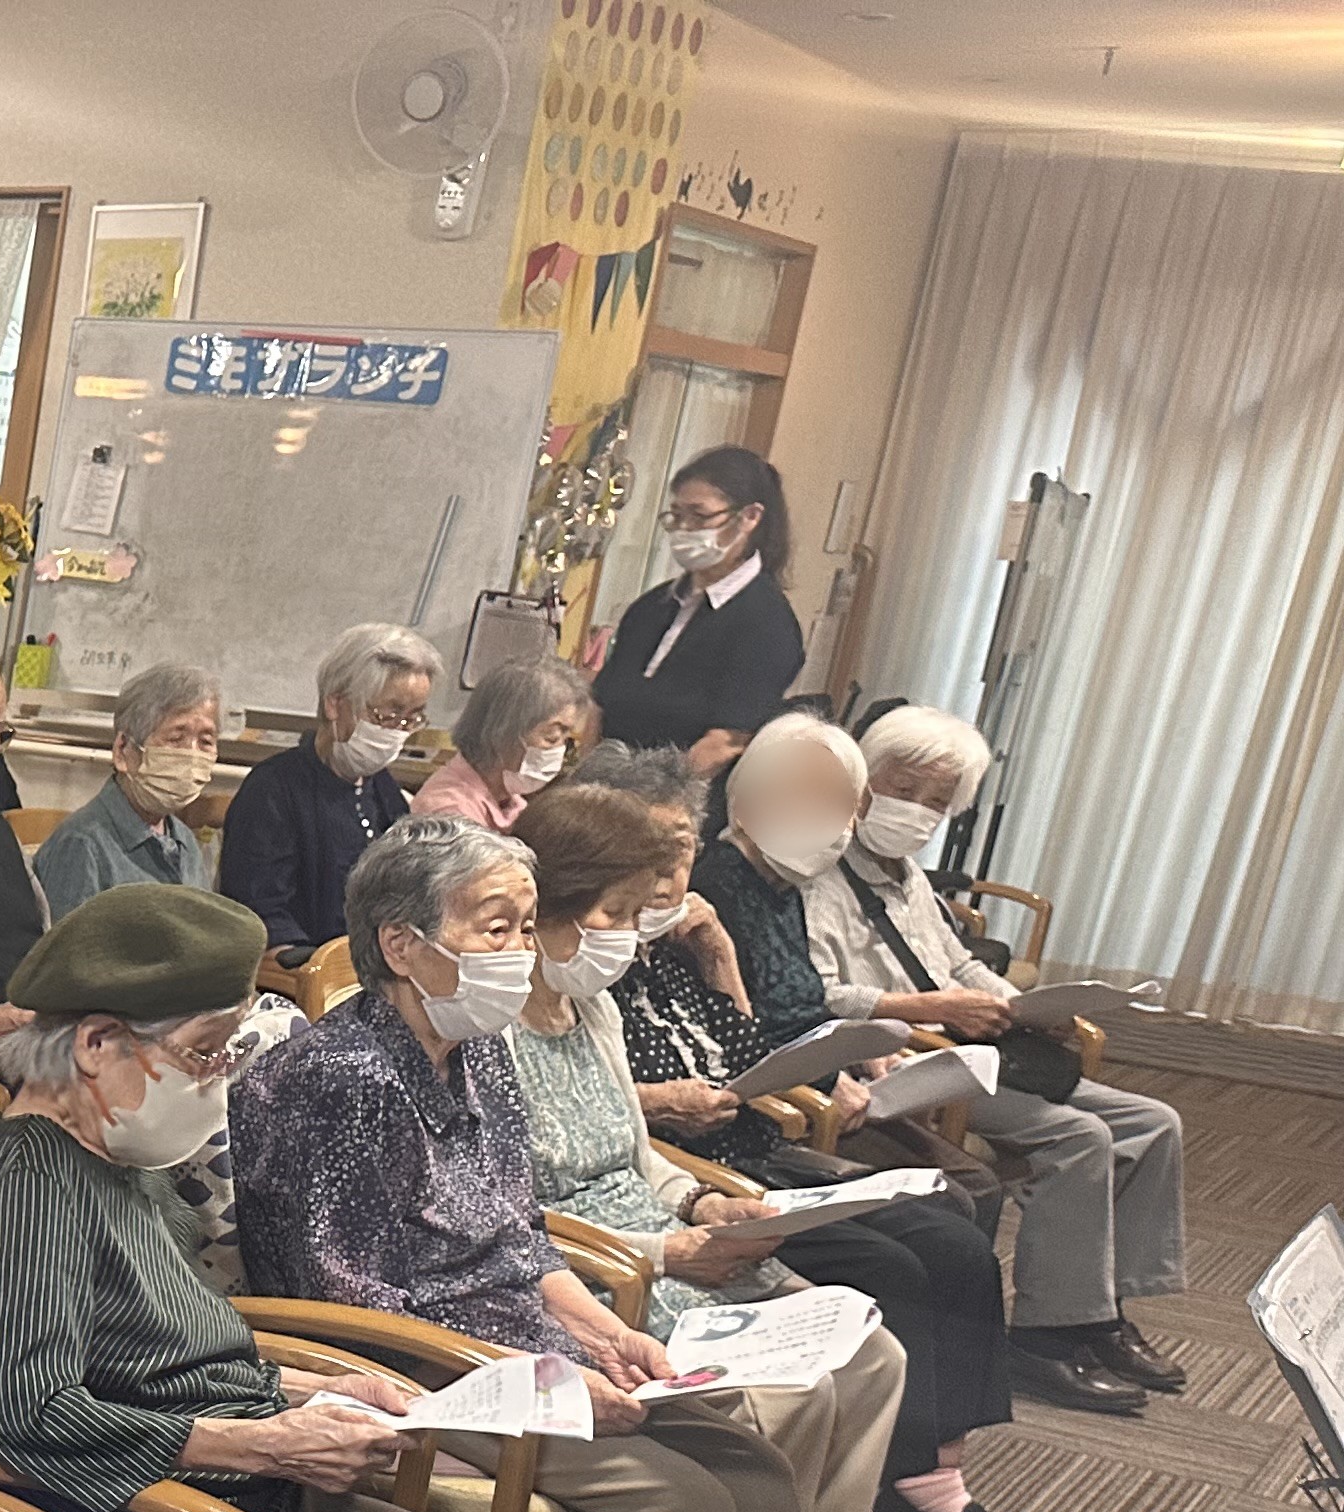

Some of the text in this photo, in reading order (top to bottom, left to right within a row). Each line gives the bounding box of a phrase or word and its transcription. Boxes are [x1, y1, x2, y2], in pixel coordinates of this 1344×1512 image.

[171, 342, 441, 400] ミモザランチ
